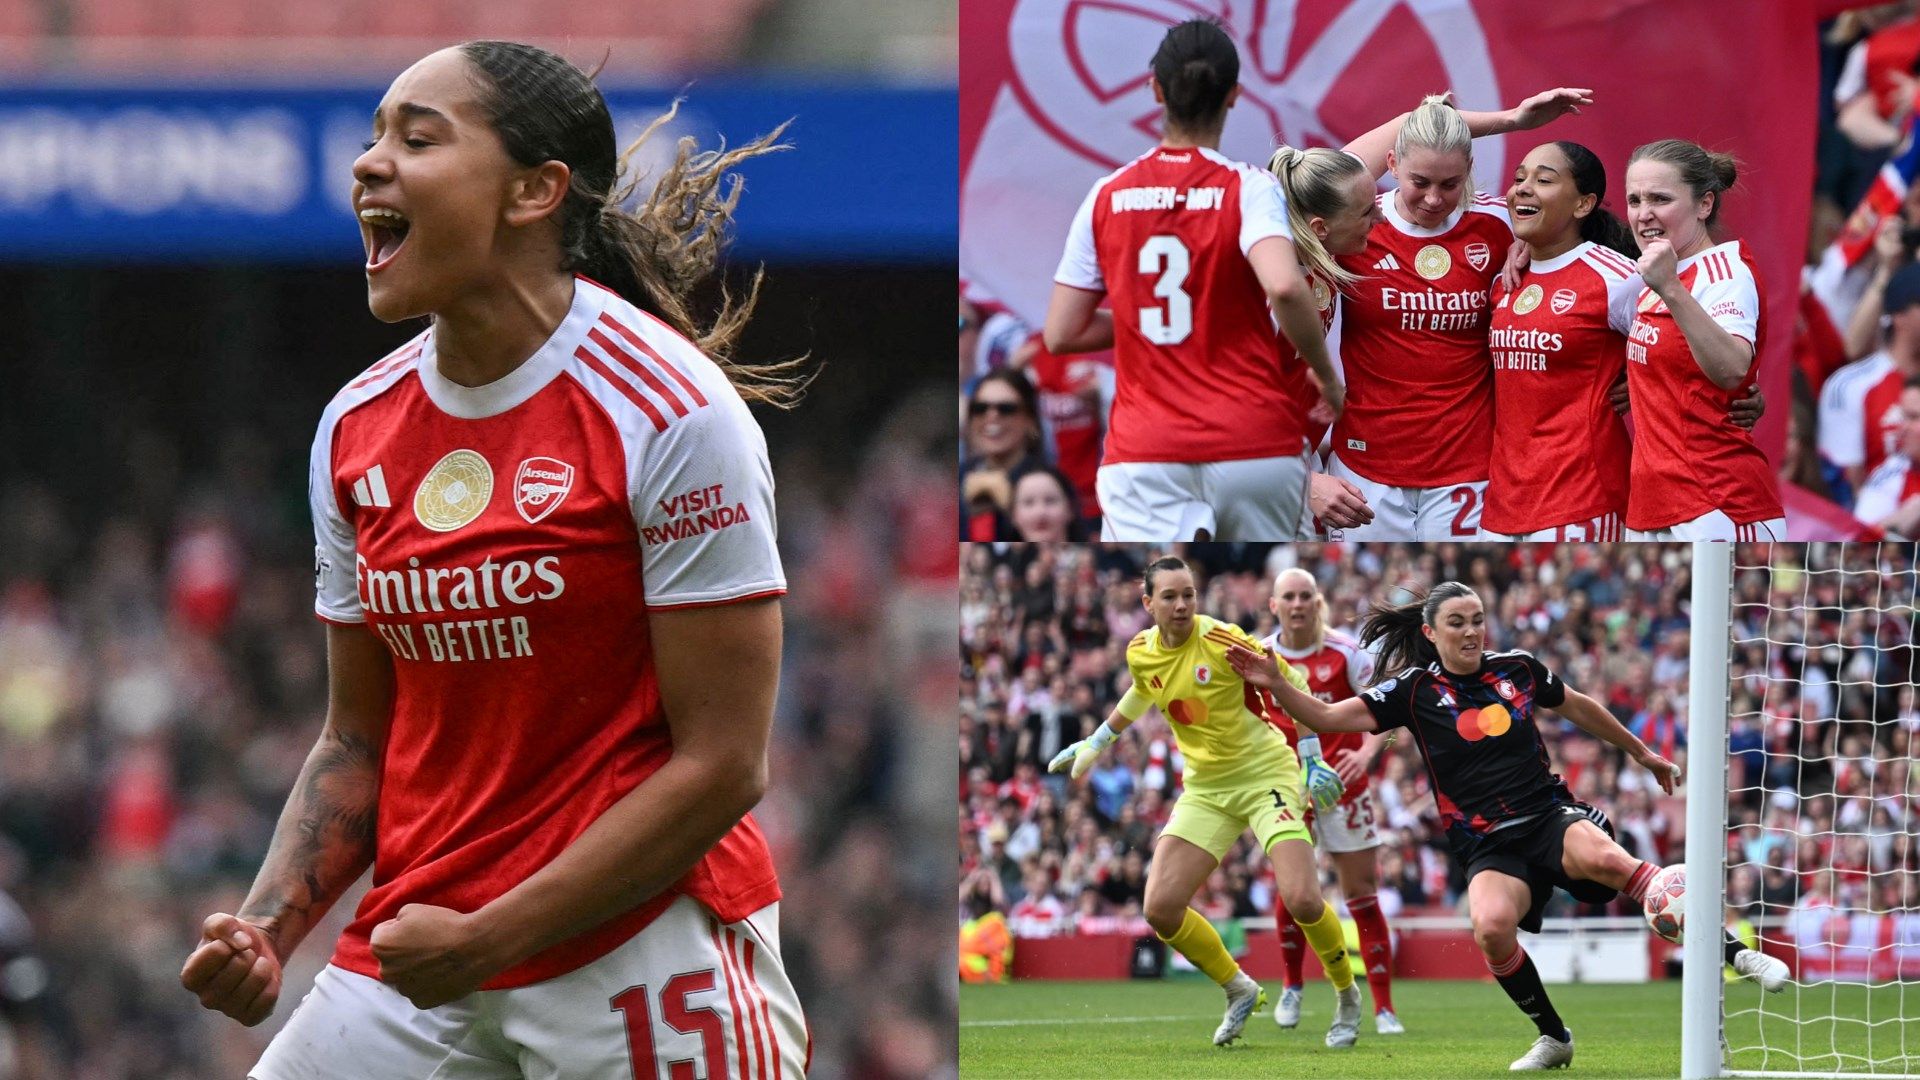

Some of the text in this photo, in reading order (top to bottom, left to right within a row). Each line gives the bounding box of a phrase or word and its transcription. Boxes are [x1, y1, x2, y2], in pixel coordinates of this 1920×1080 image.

[1111, 187, 1225, 214] WUBBEN-MOY
[1139, 235, 1193, 345] 3
[1381, 287, 1487, 311] Emirates
[1711, 301, 1735, 311] VISIT
[1711, 308, 1745, 319] WANDA
[1401, 312, 1478, 331] FLY BETTER
[1489, 325, 1563, 351] mirates
[1508, 351, 1547, 371] BETTER
[522, 467, 566, 481] Arsenal
[658, 483, 723, 518] VISIT
[640, 502, 750, 545] RWANDA
[356, 553, 566, 614] Emirates
[377, 615, 535, 662] FLY BETTER
[1268, 788, 1287, 808] 1
[1343, 796, 1374, 830] 25
[609, 967, 731, 1080] 15
